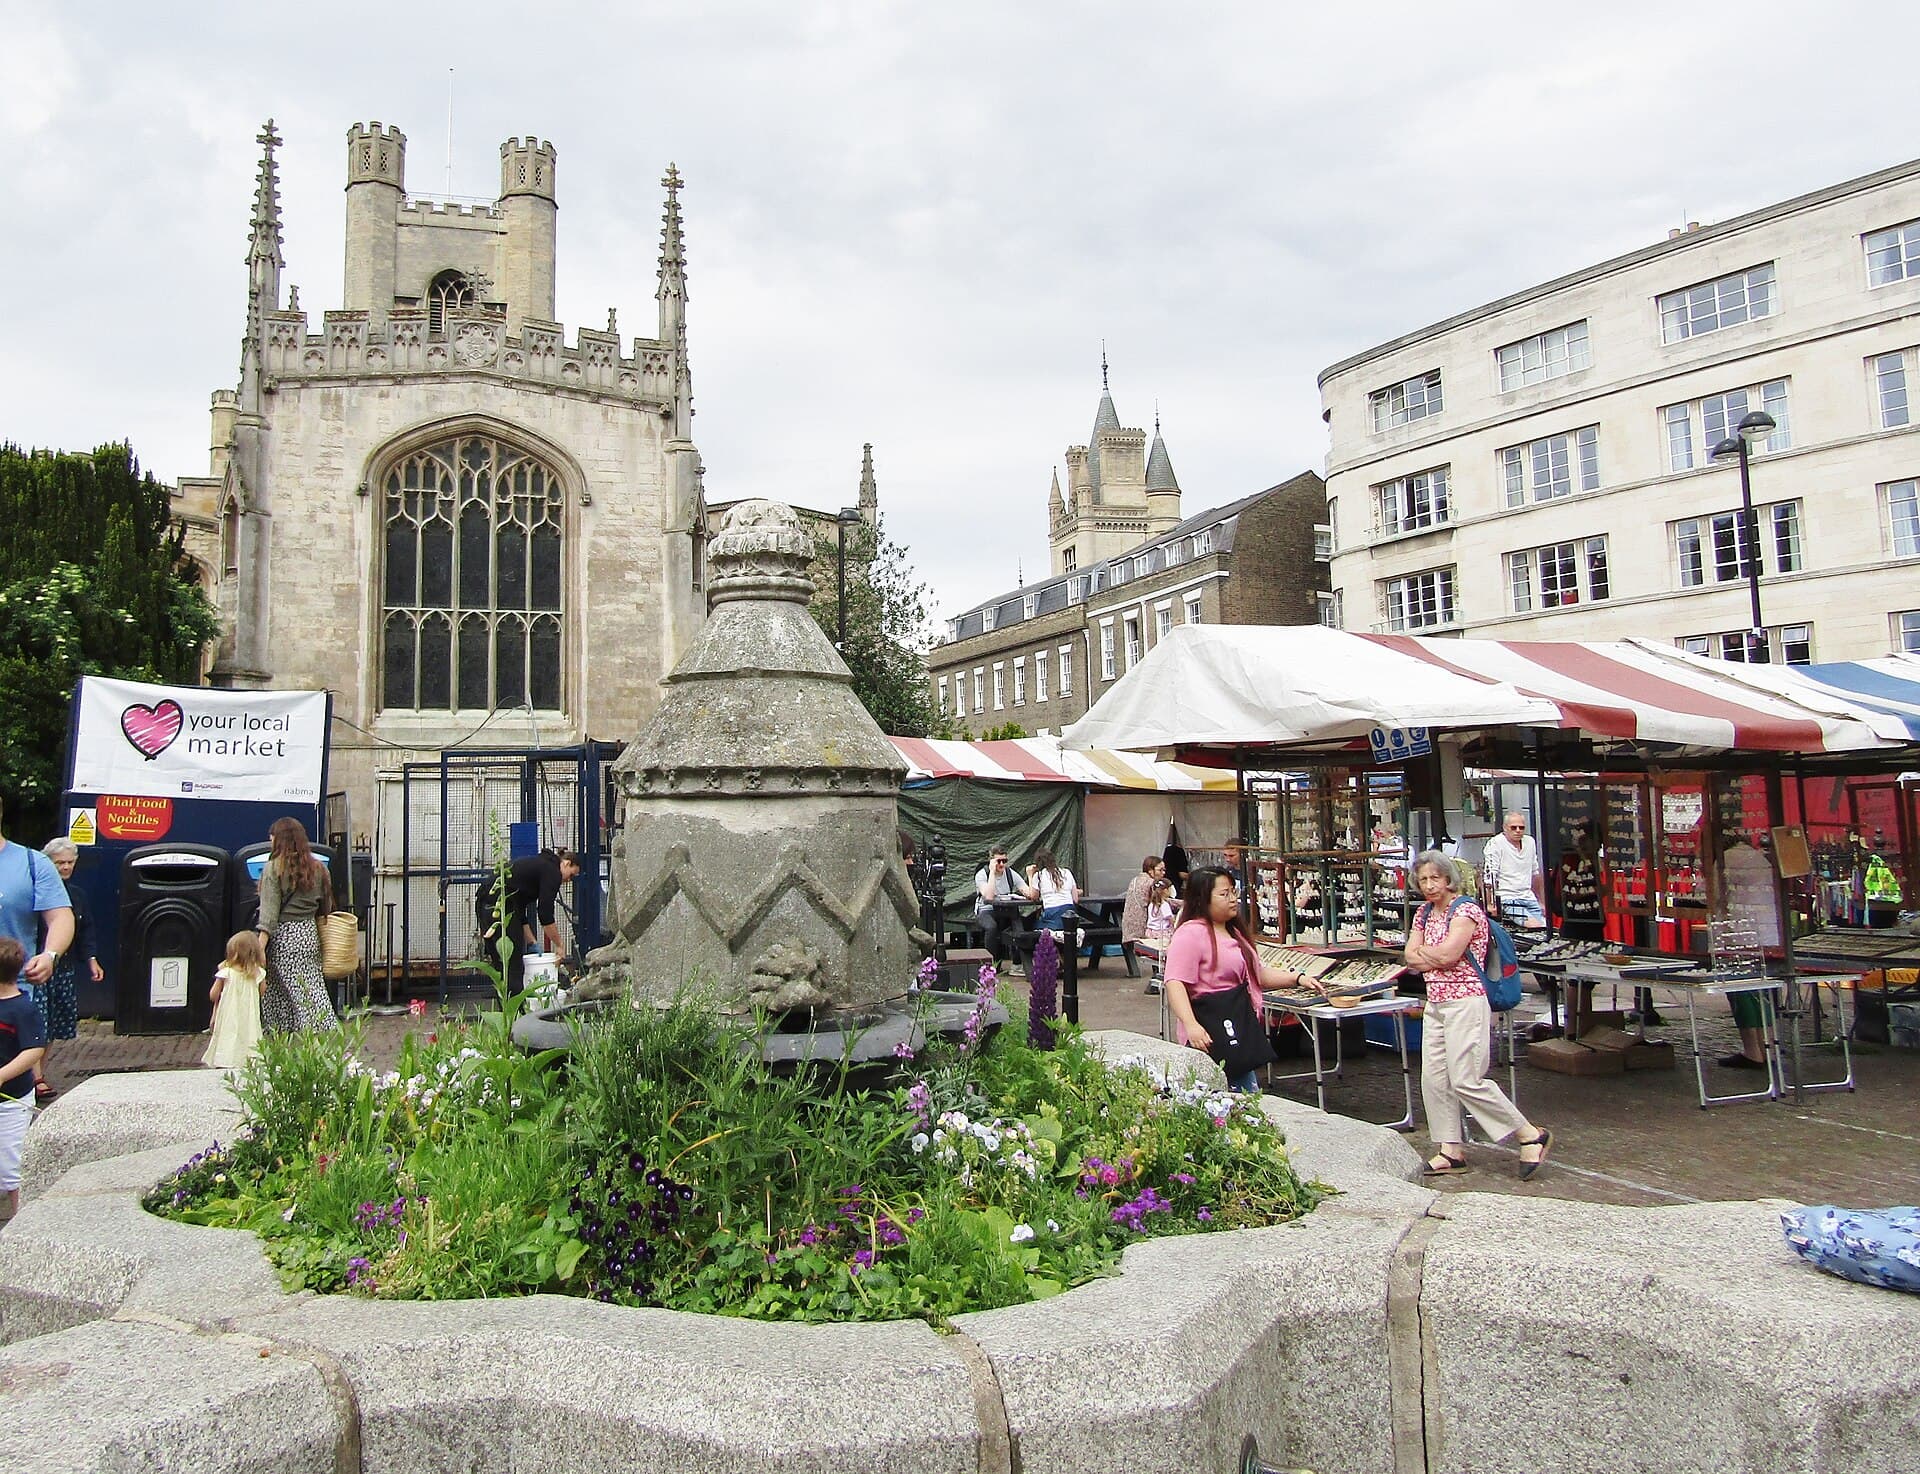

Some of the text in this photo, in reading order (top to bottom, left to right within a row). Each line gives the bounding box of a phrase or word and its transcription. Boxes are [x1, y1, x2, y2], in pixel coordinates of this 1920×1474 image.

[189, 712, 290, 732] your local
[188, 734, 286, 757] market
[104, 795, 168, 809] Thai Food
[108, 813, 160, 825] Noodles
[128, 808, 138, 816] &
